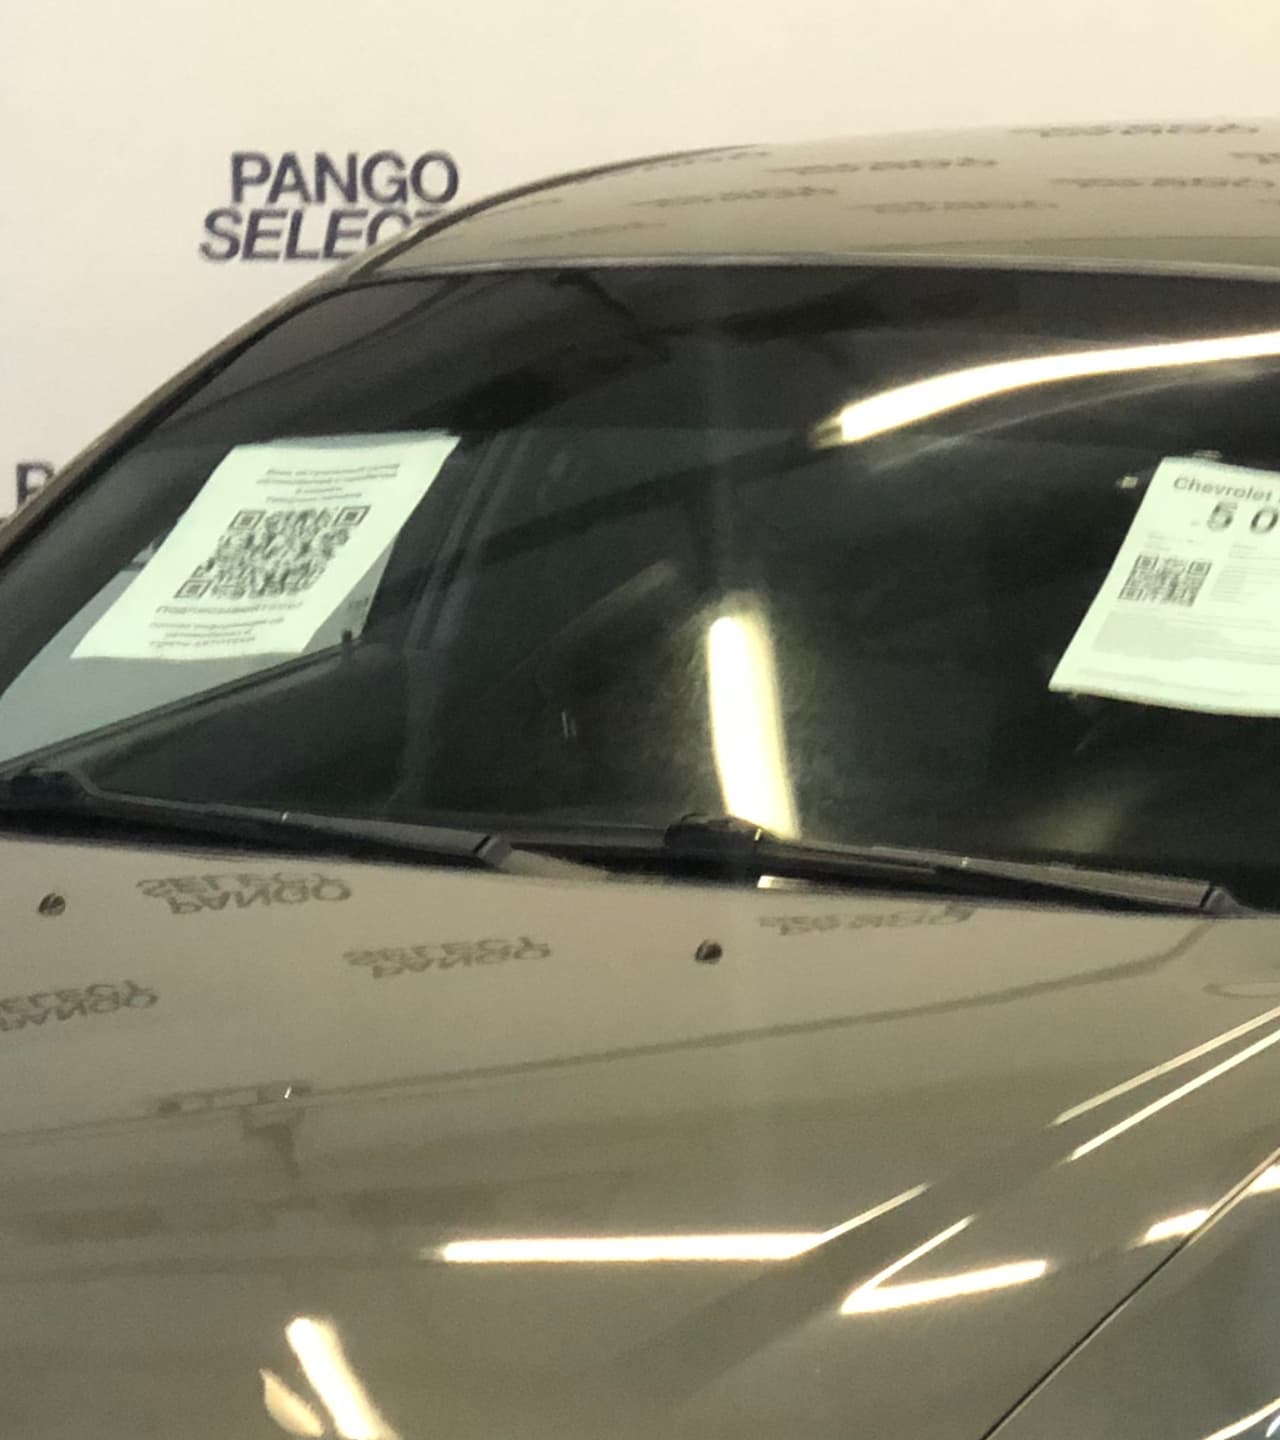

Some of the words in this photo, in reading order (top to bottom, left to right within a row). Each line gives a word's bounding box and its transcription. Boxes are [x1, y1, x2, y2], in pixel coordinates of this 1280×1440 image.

[231, 151, 459, 206] PANGO
[200, 208, 442, 262] SELEC
[1173, 477, 1273, 501] Chevrolet
